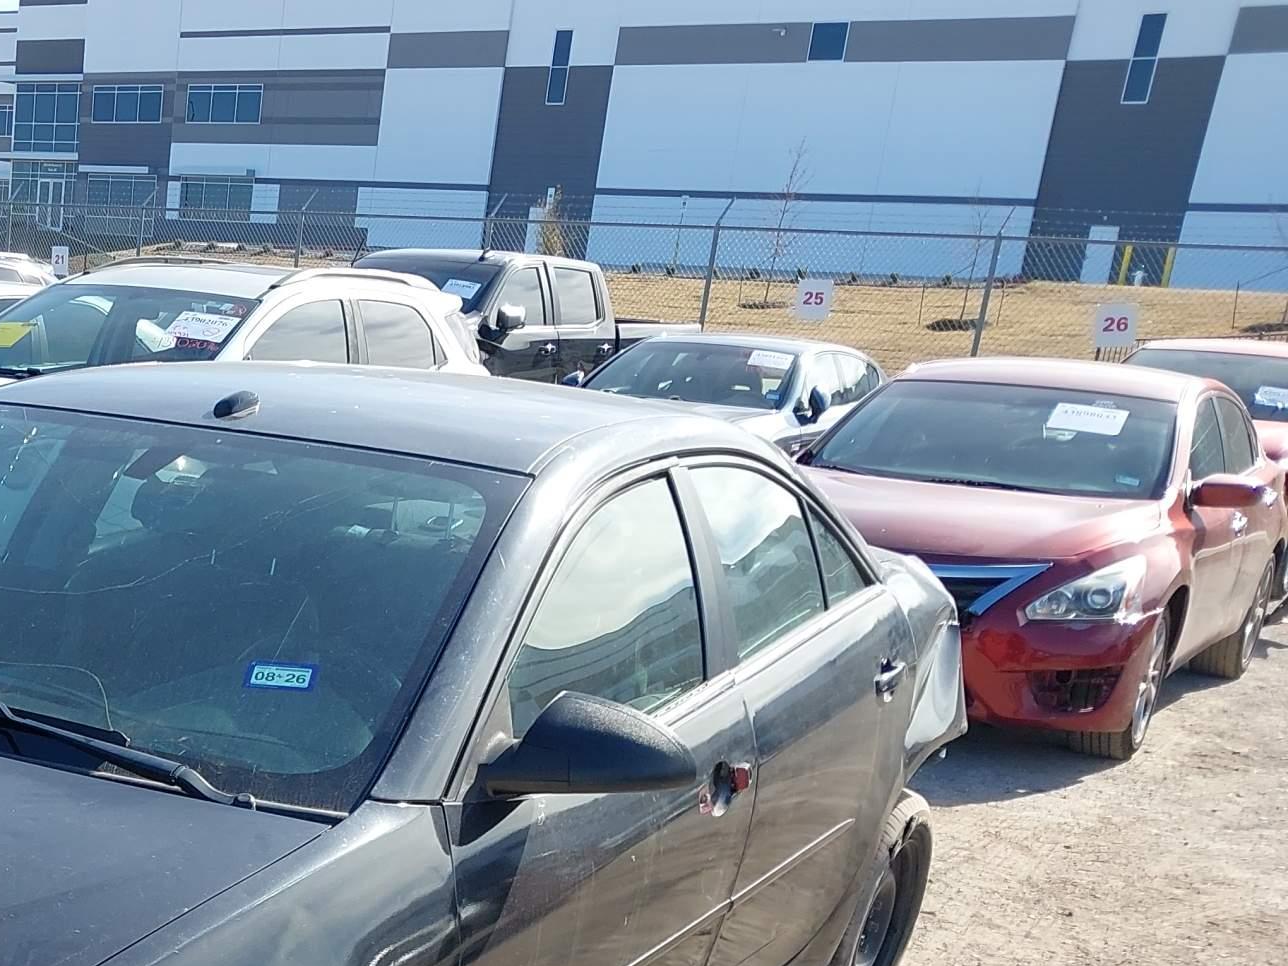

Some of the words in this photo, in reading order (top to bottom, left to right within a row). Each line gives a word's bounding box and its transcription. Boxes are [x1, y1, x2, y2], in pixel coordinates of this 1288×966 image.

[54, 254, 65, 265] 21
[803, 291, 825, 306] 25
[1102, 316, 1129, 332] 26
[254, 671, 276, 682] 08
[284, 673, 307, 685] 26
